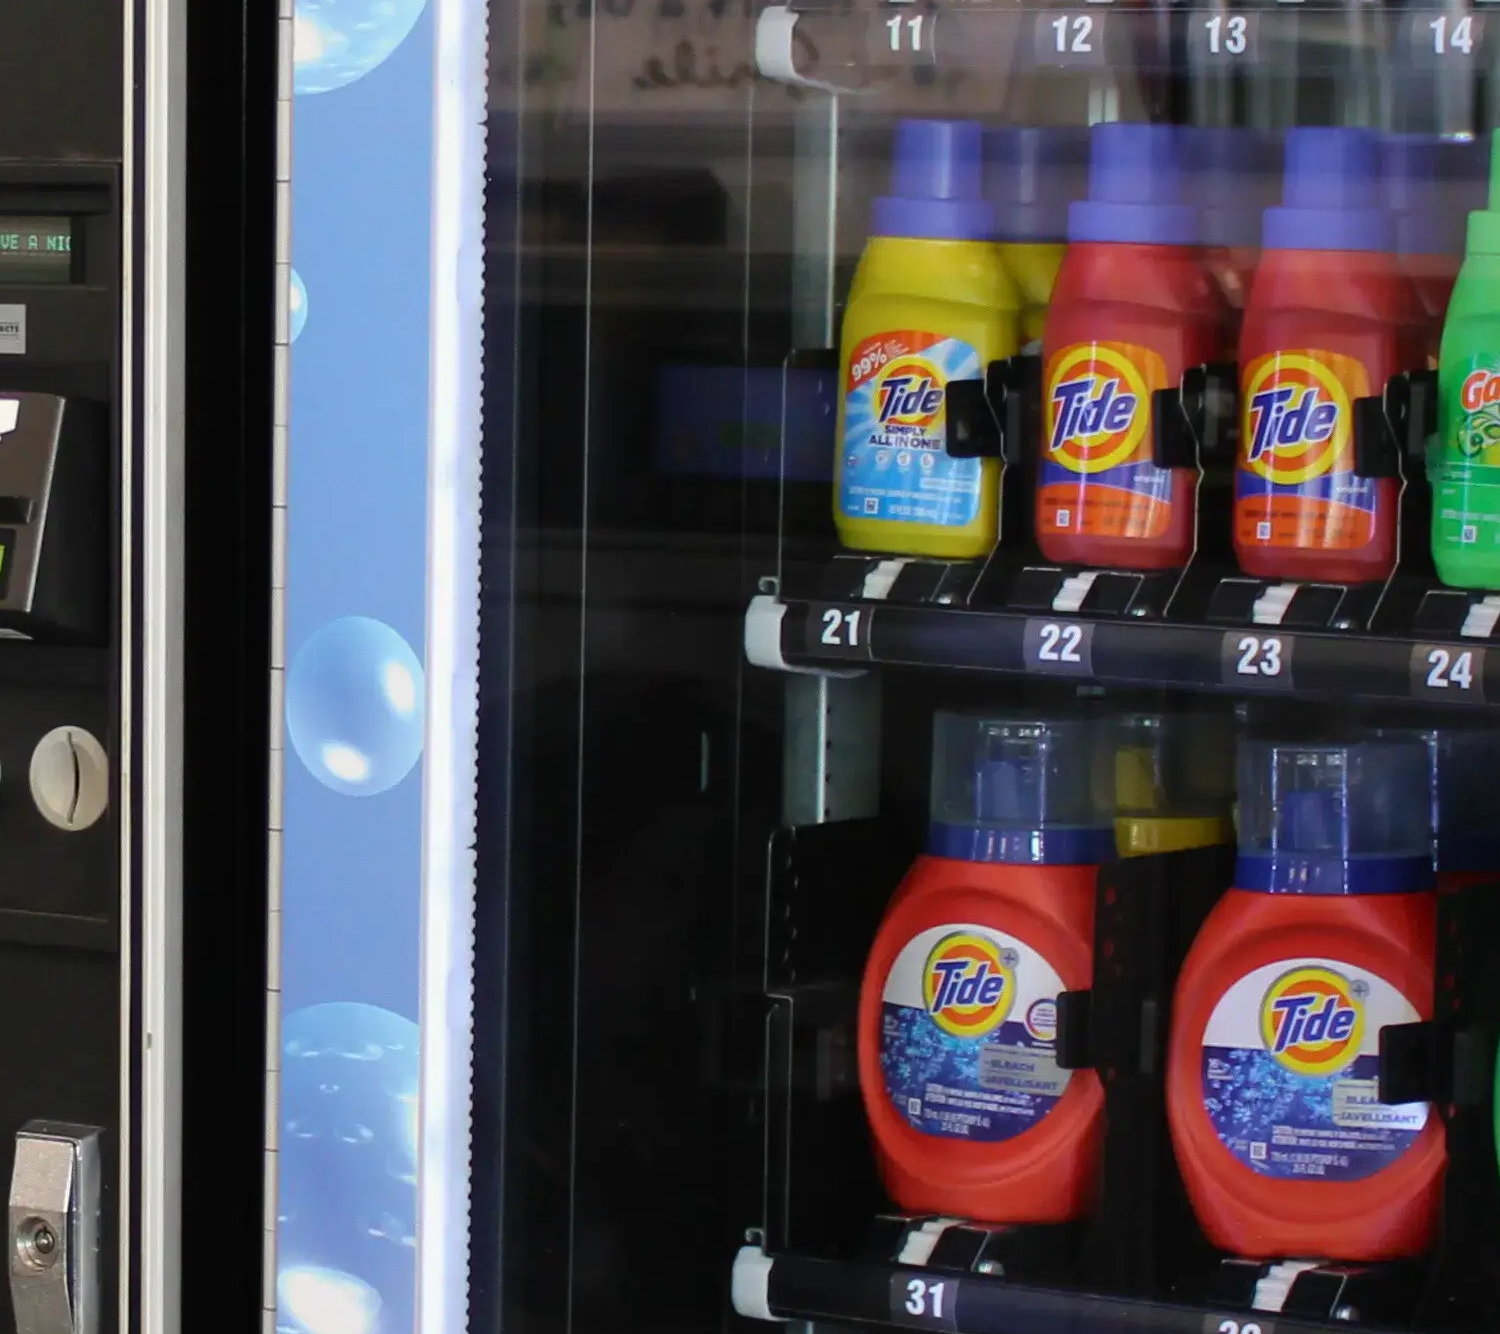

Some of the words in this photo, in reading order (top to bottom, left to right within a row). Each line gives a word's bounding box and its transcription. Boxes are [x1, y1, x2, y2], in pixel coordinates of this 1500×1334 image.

[886, 16, 923, 52] 11
[1052, 15, 1093, 52] 12
[1205, 17, 1248, 55] 13
[1430, 16, 1474, 55] 14
[28, 235, 38, 250] A
[852, 348, 887, 381] 99%
[878, 376, 945, 424] Tide
[1049, 377, 1138, 453] Tide
[869, 435, 893, 446] ALL
[895, 436, 909, 447] IN
[910, 436, 941, 450] ONE
[885, 425, 927, 437] SIMPLY
[1247, 388, 1340, 464] Tide
[820, 609, 860, 646] 21
[1038, 624, 1082, 663] 22
[1237, 638, 1282, 676] 23
[1427, 650, 1473, 690] 24
[929, 958, 1005, 1016] Tide
[1270, 995, 1357, 1055] Tide
[1346, 1095, 1379, 1105] BLEA
[905, 1279, 946, 1318] 31
